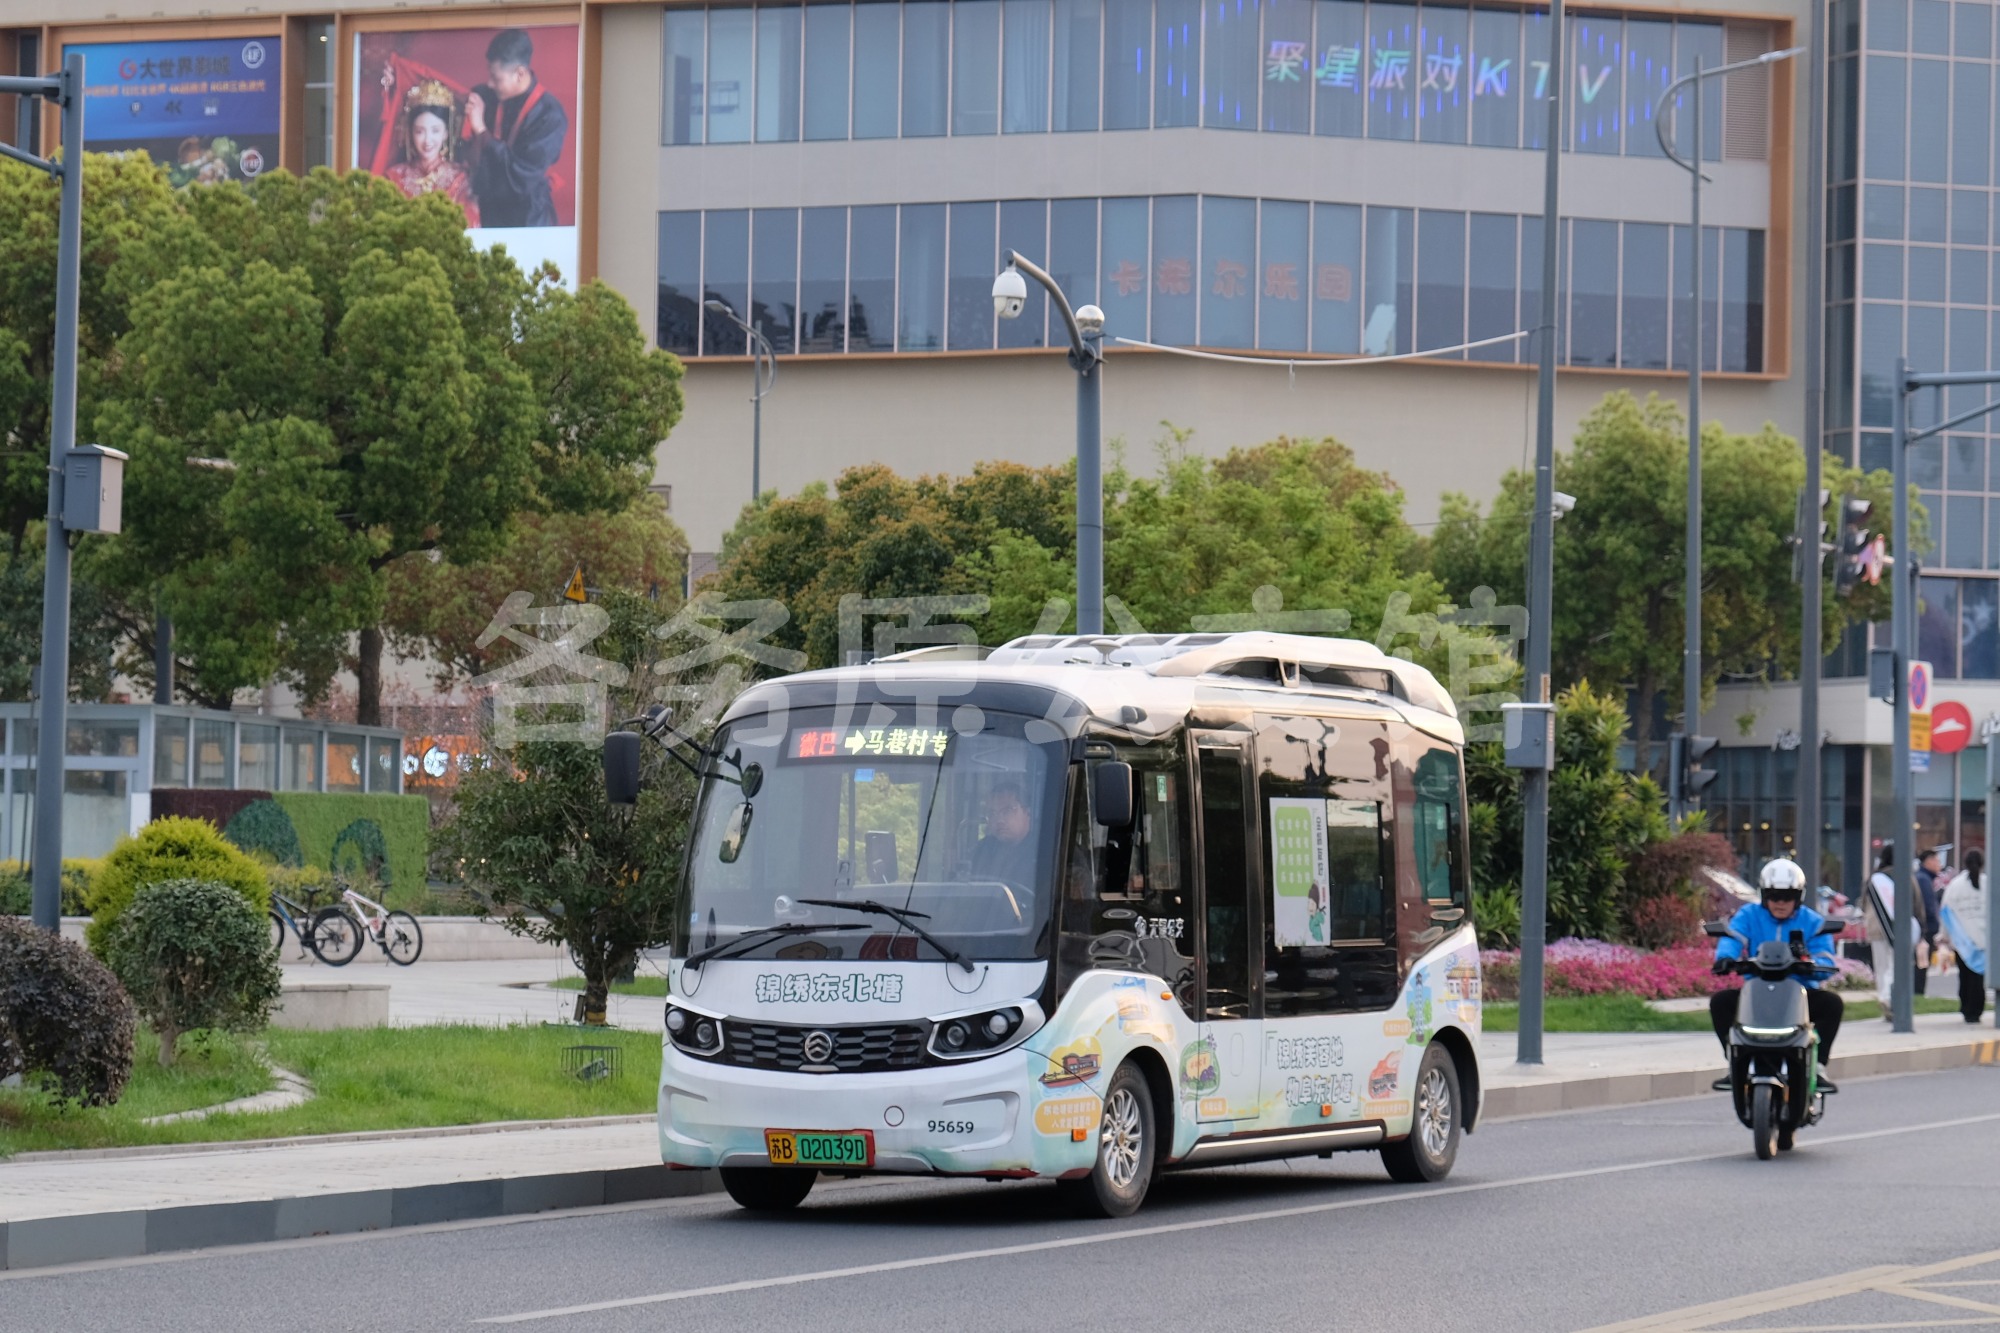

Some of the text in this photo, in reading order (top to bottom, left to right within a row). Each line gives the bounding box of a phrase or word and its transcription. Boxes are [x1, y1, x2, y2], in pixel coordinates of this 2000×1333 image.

[140, 55, 230, 80] 大世界影城
[755, 972, 903, 1003] 锦绣东北塘
[927, 1120, 975, 1134] 95659
